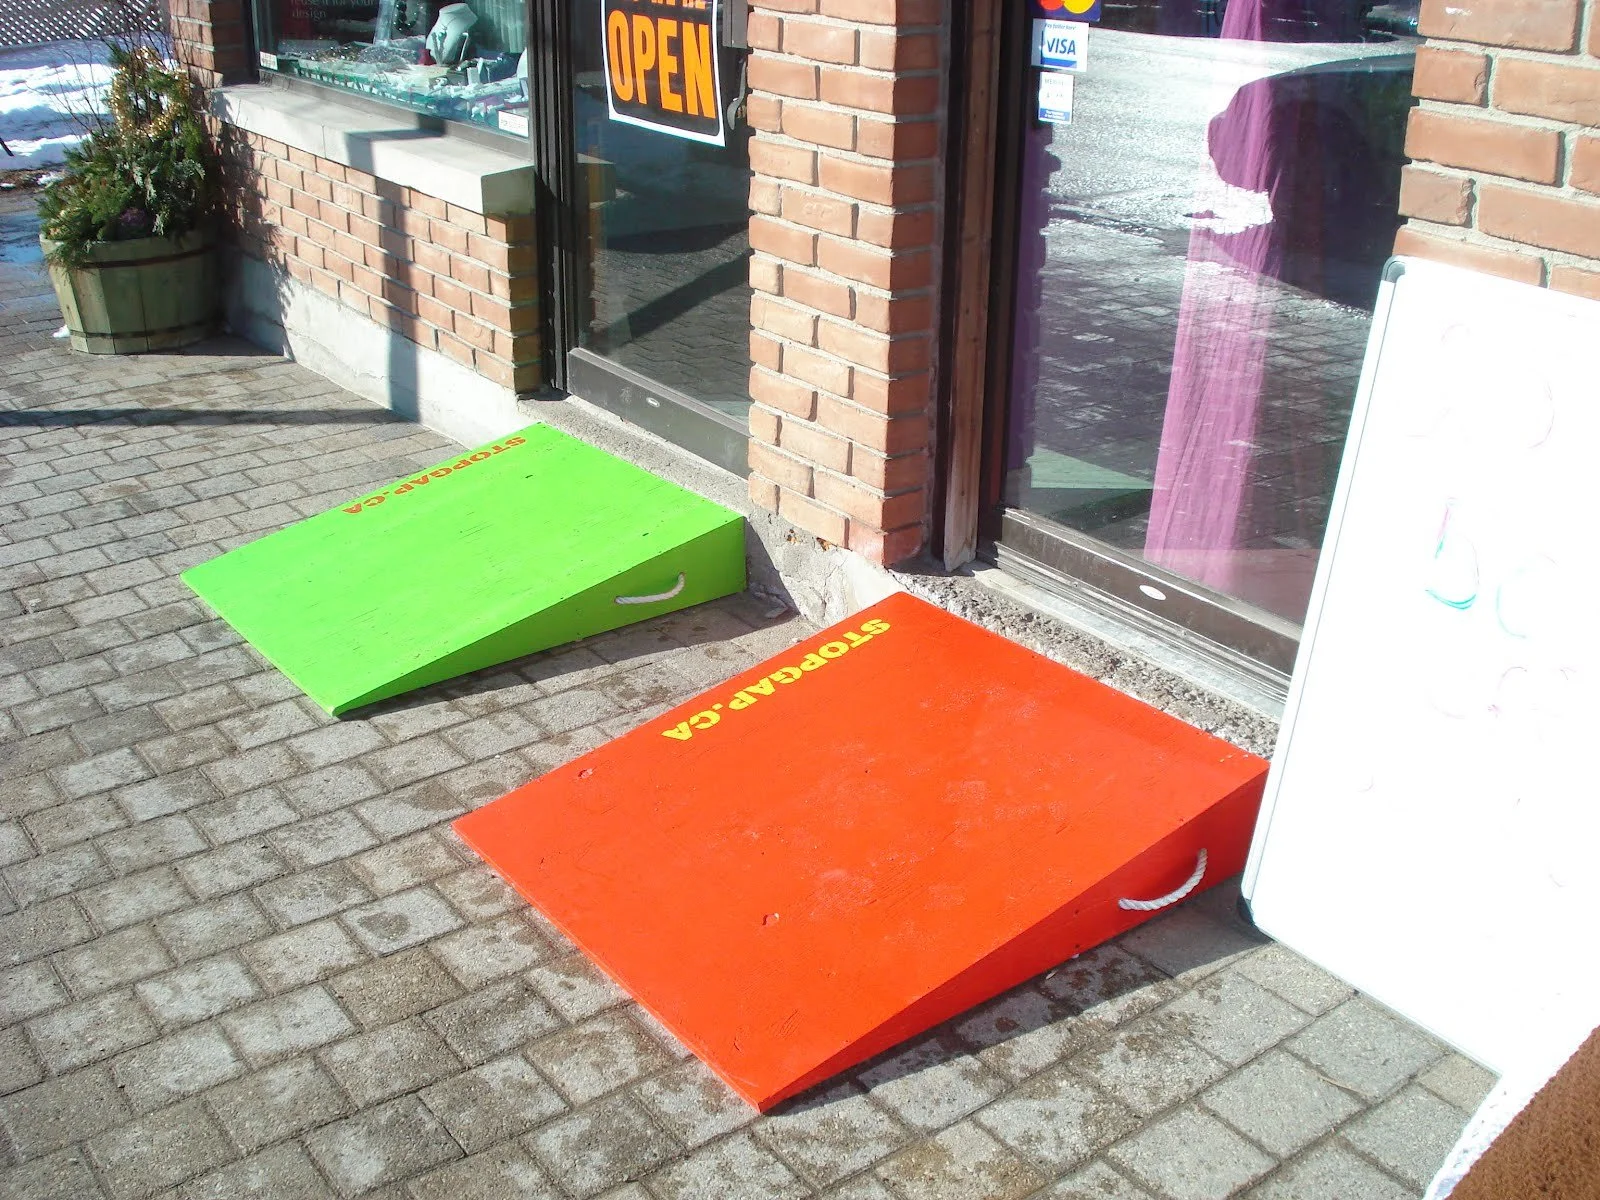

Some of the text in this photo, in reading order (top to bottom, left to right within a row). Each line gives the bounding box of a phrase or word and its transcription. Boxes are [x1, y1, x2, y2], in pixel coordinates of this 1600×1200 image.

[292, 8, 326, 21] design
[1047, 37, 1076, 56] VISA
[608, 9, 716, 119] OPEN
[342, 436, 527, 515] STOPGAP.CA
[660, 618, 891, 742] STOPGAP.CA
